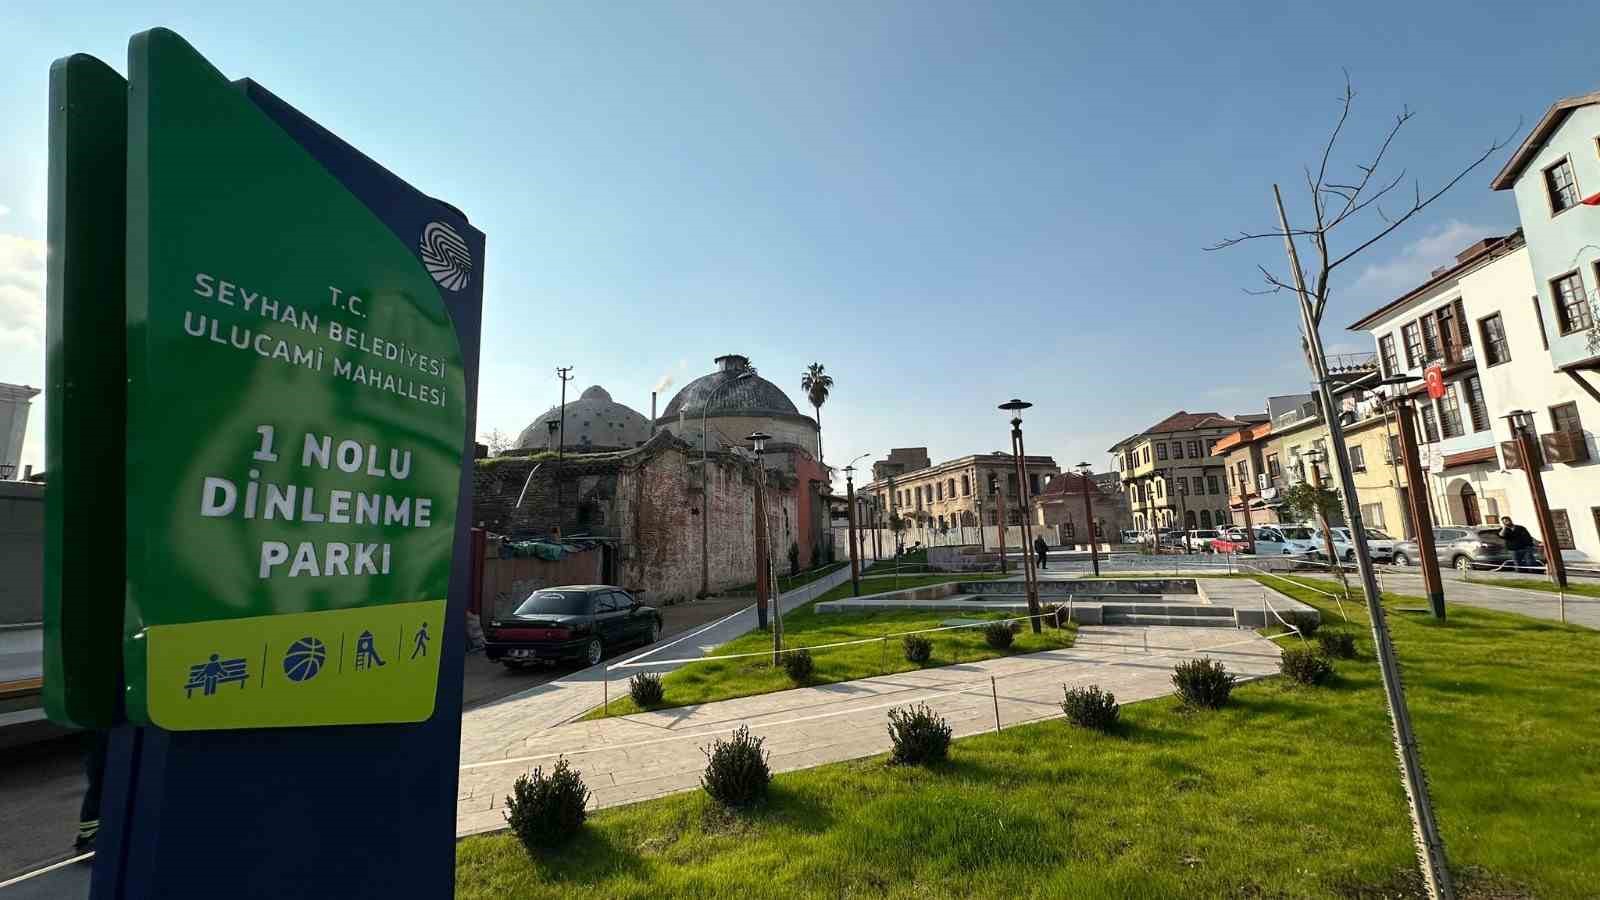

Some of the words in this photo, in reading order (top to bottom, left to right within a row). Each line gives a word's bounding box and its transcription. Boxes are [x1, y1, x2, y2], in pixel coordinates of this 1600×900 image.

[194, 273, 318, 334] SEYHAN
[328, 322, 447, 379] BELEDİYESİ
[329, 286, 368, 317] T.C.
[184, 312, 324, 370] ULUCAMİ
[334, 359, 447, 407] MAHALLESİ
[254, 425, 277, 462] 1
[302, 432, 411, 480] NOLU
[201, 470, 432, 527] DİNLENME
[259, 541, 391, 578] PARKI
